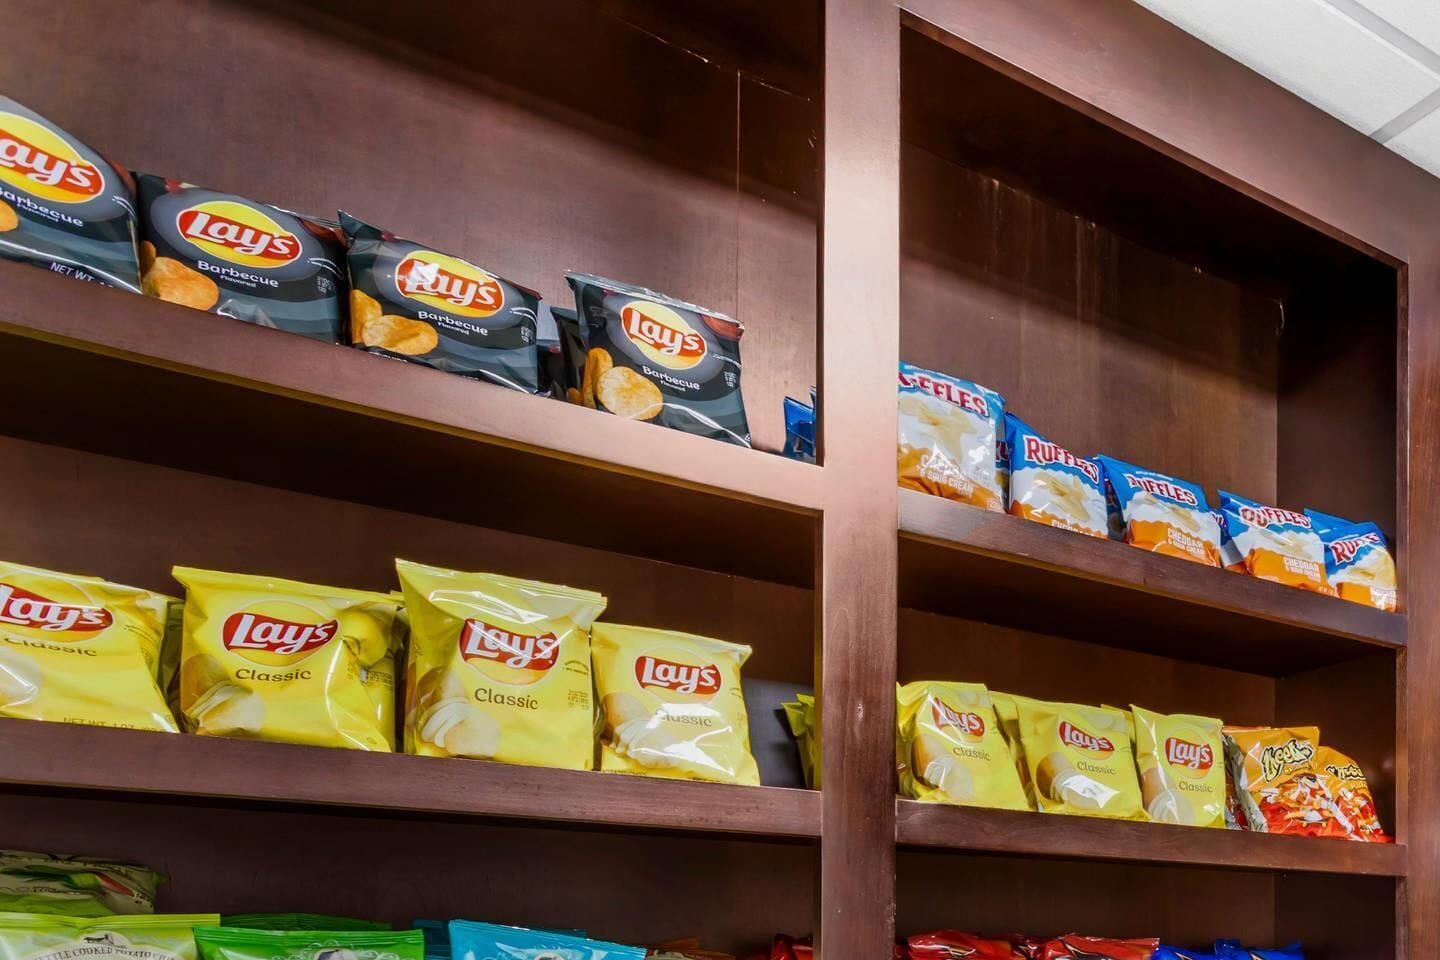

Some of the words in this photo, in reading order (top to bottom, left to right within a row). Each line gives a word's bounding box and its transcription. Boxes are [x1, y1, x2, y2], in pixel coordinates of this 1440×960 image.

[0, 138, 94, 187] ay's
[186, 211, 295, 256] Lay's
[50, 262, 73, 277] NET
[198, 260, 280, 288] Barbecue
[418, 311, 489, 336] Barbecue
[628, 309, 700, 356] Lay's
[642, 365, 701, 390] Barbecue
[1167, 527, 1203, 549] CHEDDAR
[1283, 556, 1320, 571] CHEDDAR
[226, 614, 329, 654] Lay's
[464, 617, 559, 668] Lay's
[235, 667, 312, 682] Classic
[641, 656, 719, 694] Lay's
[474, 687, 538, 711] Classic
[1065, 723, 1111, 752] Lay's
[952, 746, 992, 761] Classic
[1168, 738, 1211, 769] Lay's
[1077, 760, 1116, 775] Classic
[1179, 780, 1213, 793] Classic
